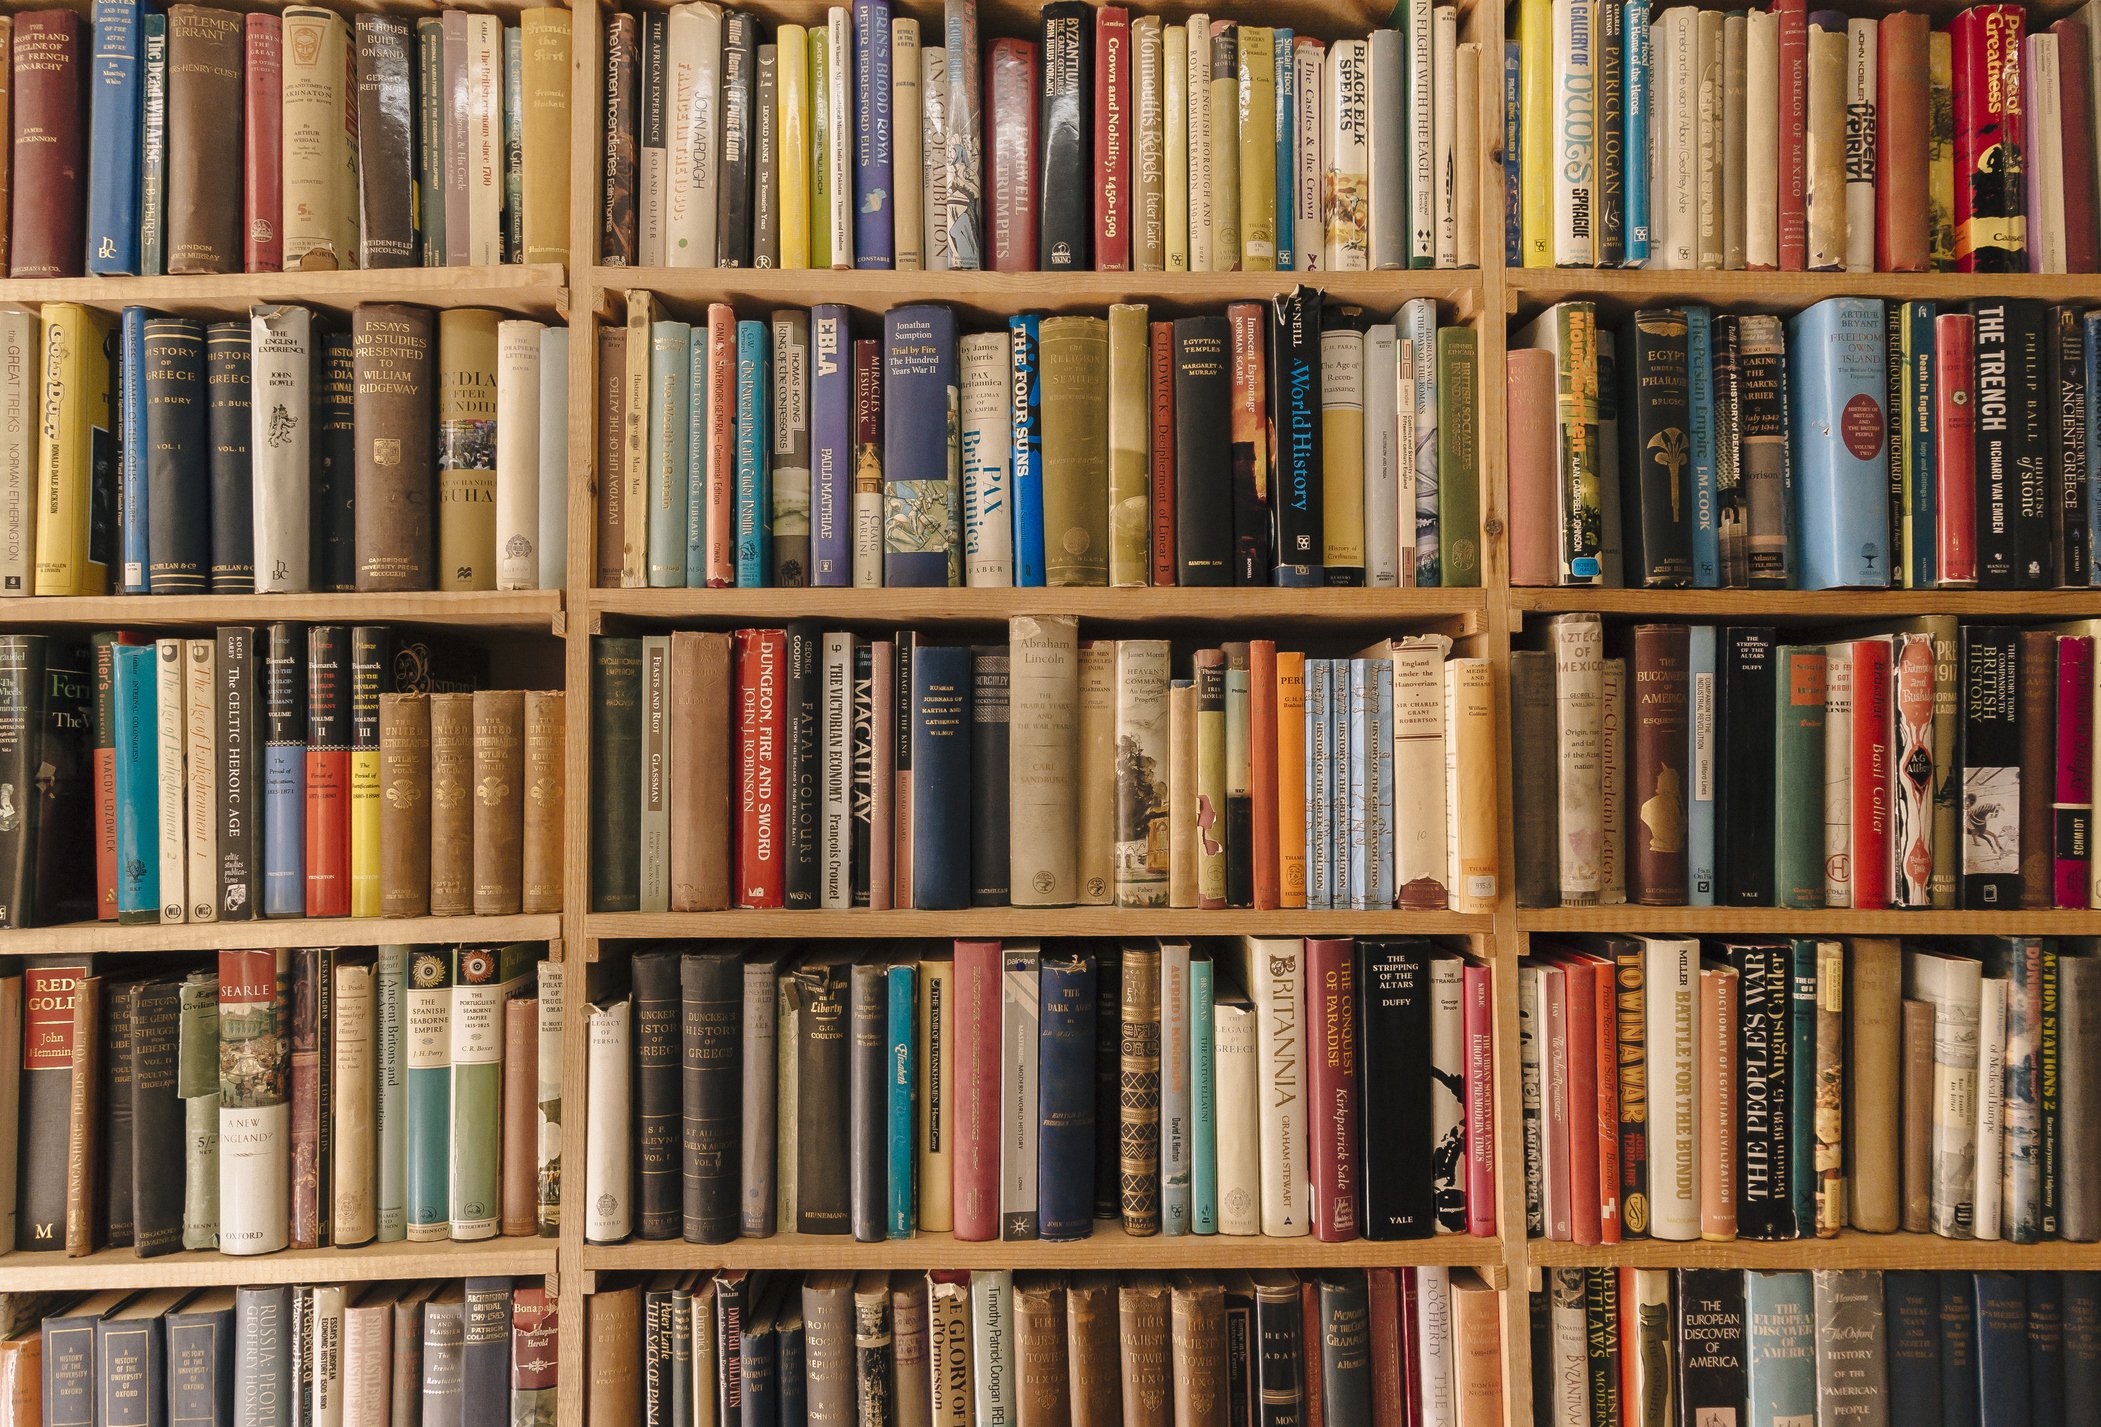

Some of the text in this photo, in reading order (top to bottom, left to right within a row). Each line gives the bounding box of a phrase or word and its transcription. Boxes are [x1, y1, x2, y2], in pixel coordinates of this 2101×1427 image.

[653, 22, 661, 40] THE
[1066, 18, 1079, 94] BYZANTIUM
[1986, 12, 2002, 113] Greatness
[146, 35, 163, 164] The Dead Will Arise
[651, 86, 660, 142] EXPERIENCE
[875, 5, 889, 167] ERIN'S BLOOD ROYAL
[1141, 26, 1160, 183] Monmouth's Rebels
[1340, 59, 1352, 131] SPEAKS
[1354, 45, 1365, 146] BLACK ELK
[1417, 2, 1429, 182] IN FLIGHT WITH THE EAGLE
[1605, 47, 1619, 194] PATRICK LOGAN
[1792, 60, 1801, 197] MORELOS OF MEXICO
[693, 92, 707, 189] JOHN ARDAGH
[1105, 38, 1119, 237] Crown and Nobility, 1450-1509
[1306, 62, 1315, 219] The Castles & the Crown
[649, 152, 658, 239] ROLAND OLIVER
[1572, 189, 1589, 239] SPRAGUE
[817, 318, 837, 376] EBLA
[895, 331, 932, 339] Sumption
[897, 321, 930, 329] Jonathan
[7, 331, 20, 433] the GREAT TREKS
[360, 384, 418, 395] RIDGEWAY
[364, 371, 411, 382] WILLIAM
[791, 352, 800, 422] THOMAS HOVING
[1918, 354, 1929, 432] Death in England
[1979, 306, 2006, 431] THE TRENCH
[1156, 332, 1169, 573] CHADWICK: Decipherment of Linear B
[1291, 365, 1312, 511] World History
[2062, 380, 2077, 508] ANCIENT GREECE
[822, 448, 832, 538] PAOLO MATTHIAE
[964, 429, 982, 555] Britannica
[982, 467, 1003, 515] PAX
[1991, 441, 2003, 534] RICHARD VAN EMDEN
[1970, 644, 1982, 723] HISTORY
[1983, 646, 1997, 720] BRITISH
[228, 667, 240, 837] The CELTIC HEROIC AGE
[741, 686, 755, 812] JOHN J. ROBINSON
[758, 642, 773, 861] DUNGEON, FIRE AND SWORD
[829, 663, 843, 803] THE VICTORIAN ECONOMY
[103, 754, 116, 853] YAACOV LOZOWICK
[1603, 678, 1617, 884] The Chamberlain Letters
[1872, 743, 1884, 835] Basil Collier
[827, 814, 842, 900] François Crouzet
[2074, 818, 2085, 856] SCHMIDT
[36, 978, 75, 992] RED
[221, 984, 269, 996] SEARLE
[1373, 962, 1418, 972] STRIPPING
[1382, 999, 1411, 1007] DUFFY
[1679, 950, 1687, 985] MILLER
[410, 1016, 448, 1024] SEABORNE
[414, 1026, 444, 1034] EMPIRE
[688, 1048, 733, 1059] GREECE
[1269, 954, 1297, 1108] BRITANNIA
[1326, 971, 1339, 1068] OF PARADISE
[1340, 960, 1353, 1076] THE CONQUEST
[2043, 950, 2056, 1111] ACTION STATIONS 2
[1675, 991, 1692, 1200] BATTLE FOR THE BUNDU
[1743, 952, 1769, 1201] THE PEOPLE'S WAR
[1281, 1116, 1292, 1208] GRAHAM STEWART
[1333, 1088, 1349, 1189] Kirkpatrick Sale
[1389, 1216, 1413, 1224] YALE
[329, 1317, 338, 1340] ESSAYS
[728, 1307, 741, 1408] DMITRII MILIUTIN
[987, 1286, 1003, 1402] Timothy Patrick Coogan
[1427, 1279, 1439, 1359] DOCHERTY
[1439, 1294, 1448, 1341] PADDY
[1684, 1328, 1741, 1339] DISCOVERY
[1686, 1315, 1739, 1325] EUROPEAN
[1828, 1350, 1872, 1360] HISTORY
[111, 1373, 142, 1381] UNIVERSITY
[114, 1357, 138, 1365] HISTORY
[115, 1390, 138, 1398] OXFORD
[1689, 1356, 1738, 1367] AMERICA
[1825, 1385, 1877, 1395] AMERICAN
[1834, 1405, 1870, 1415] PEOPLE
